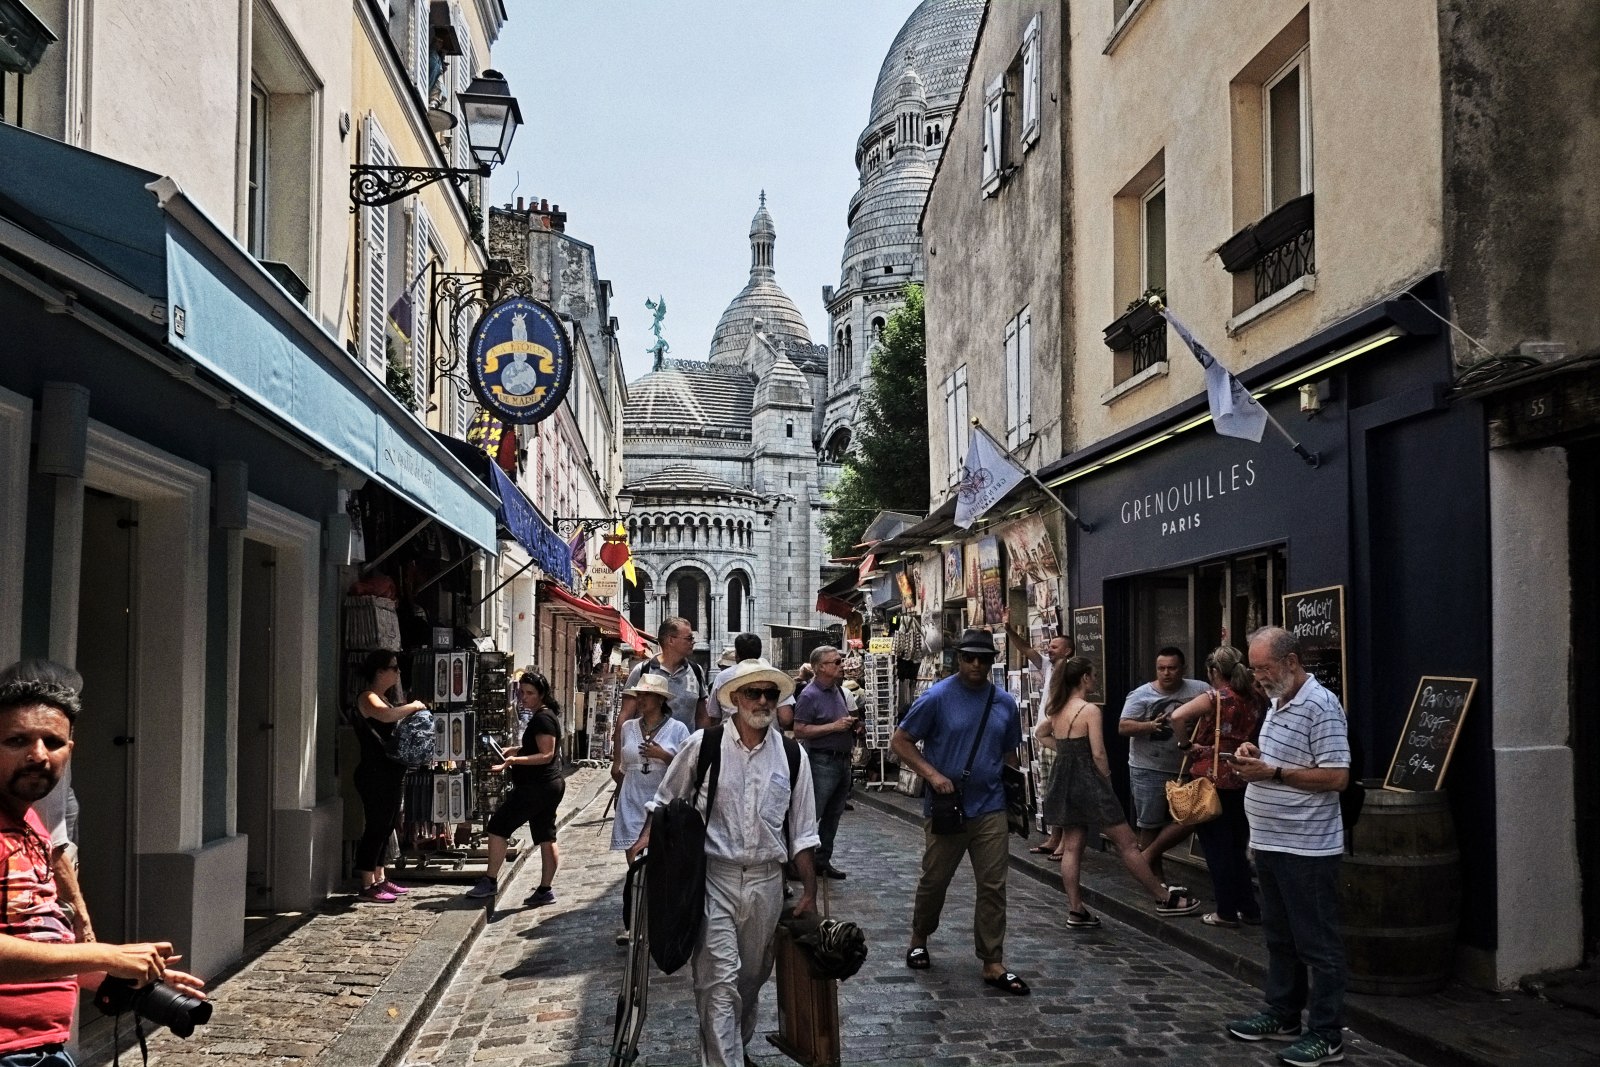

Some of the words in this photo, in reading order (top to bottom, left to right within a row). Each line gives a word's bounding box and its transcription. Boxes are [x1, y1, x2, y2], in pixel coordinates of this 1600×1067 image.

[1531, 398, 1545, 417] 55
[1121, 459, 1256, 524] GRENOUILLES
[1161, 513, 1201, 536] PARIS
[1297, 598, 1333, 621] FRENCHY
